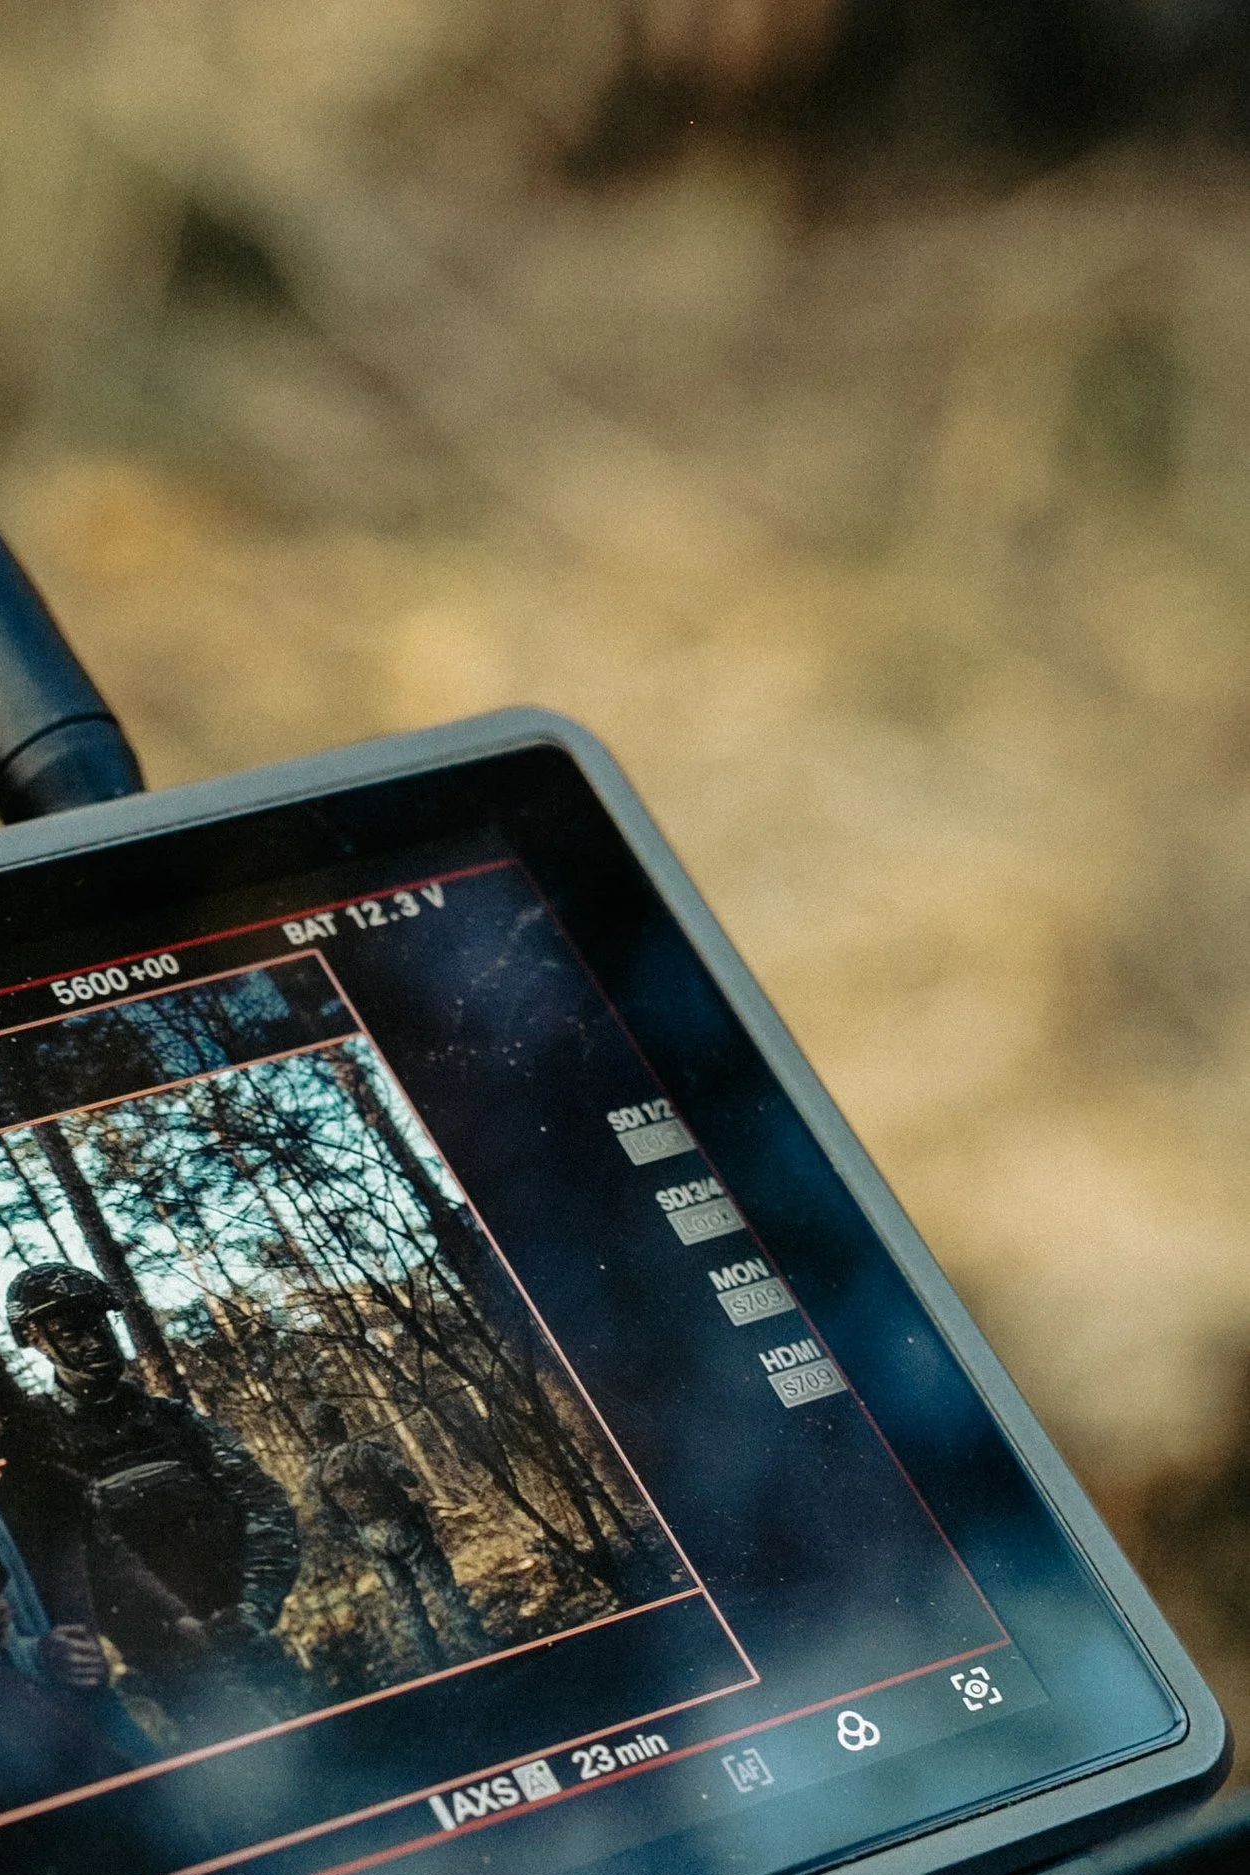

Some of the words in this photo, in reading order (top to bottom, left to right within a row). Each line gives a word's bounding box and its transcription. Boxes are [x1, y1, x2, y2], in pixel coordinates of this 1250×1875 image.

[282, 911, 338, 946] BAT
[345, 889, 421, 931] 12.3
[420, 877, 447, 909] V
[707, 1256, 771, 1292] MON
[758, 1337, 823, 1373] HDMI
